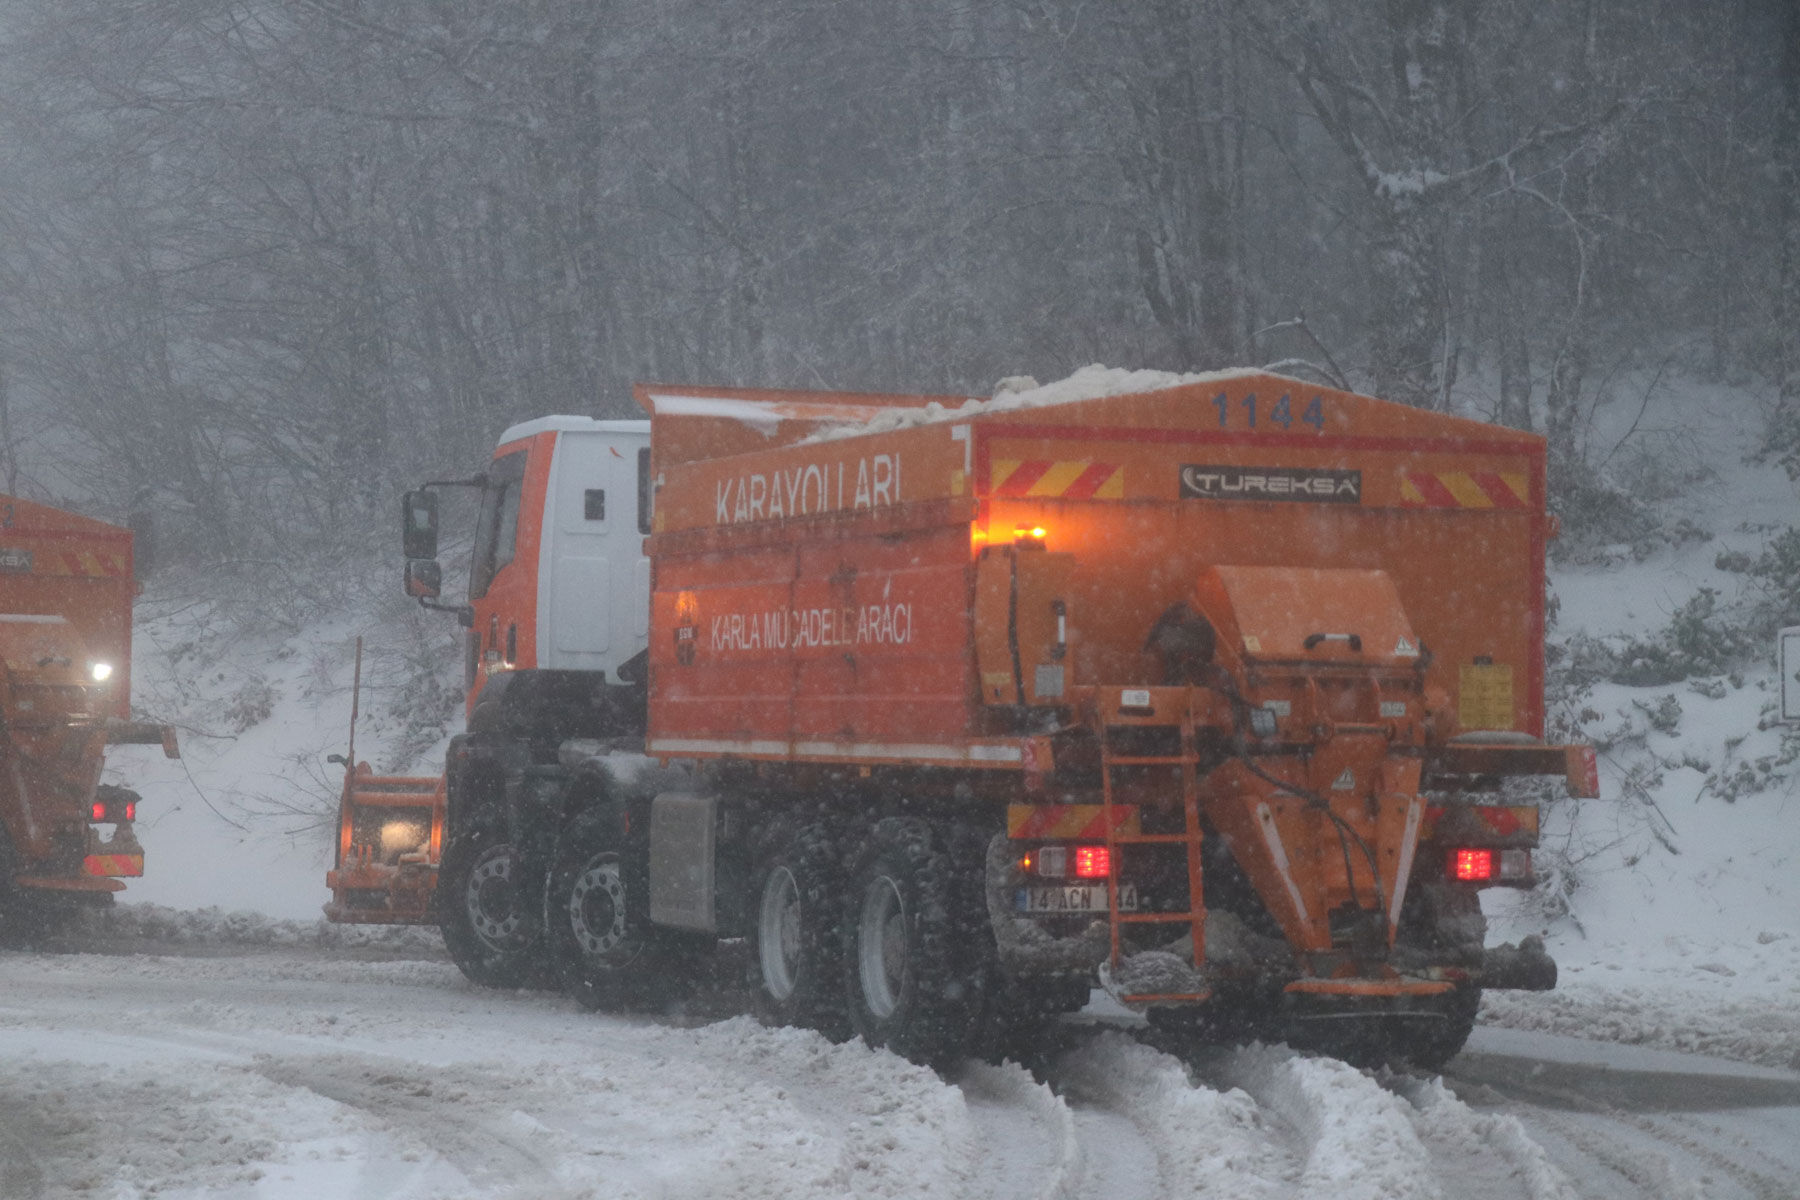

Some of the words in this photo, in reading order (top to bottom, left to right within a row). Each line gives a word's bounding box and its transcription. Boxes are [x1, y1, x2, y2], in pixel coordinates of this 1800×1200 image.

[1211, 392, 1326, 429] 1144
[711, 613, 761, 650] KARLA
[856, 602, 912, 644] ARACI
[1057, 888, 1092, 909] ACN
